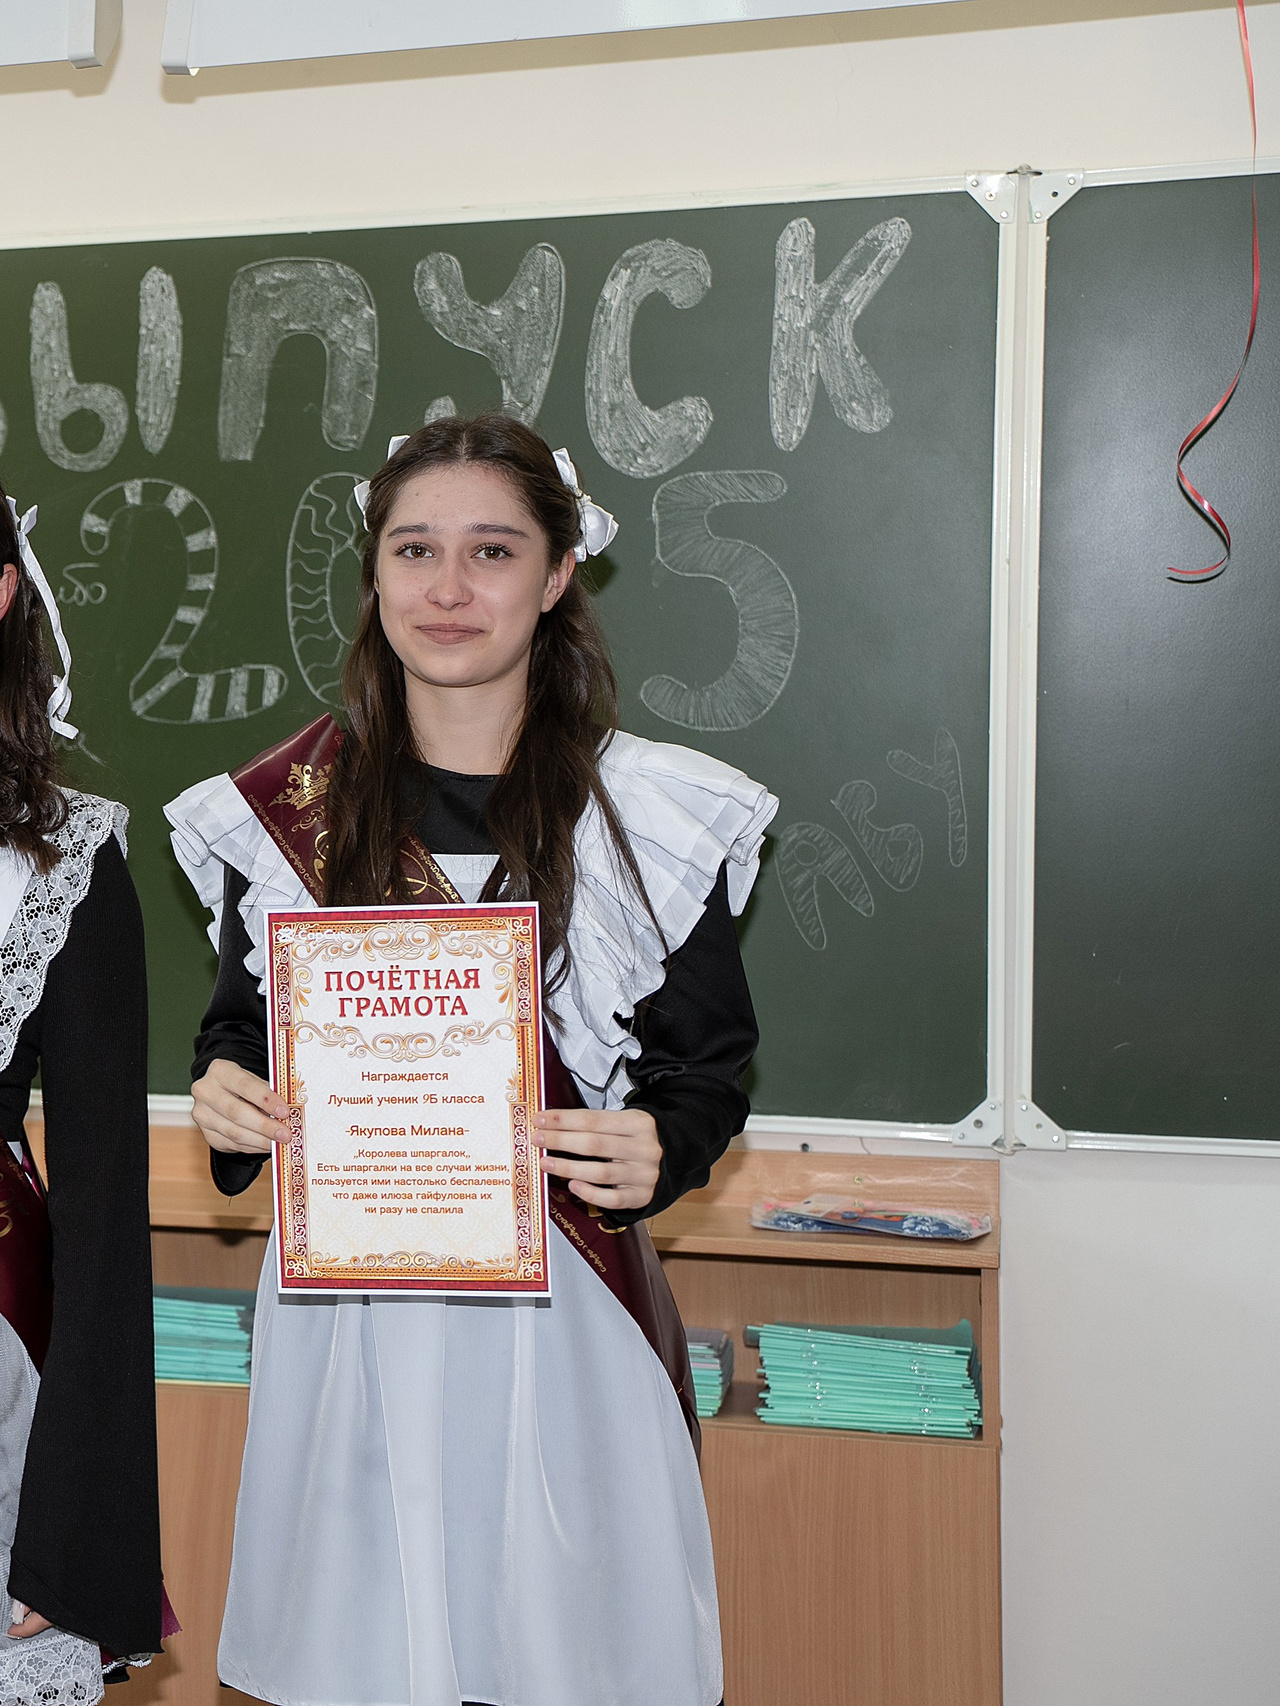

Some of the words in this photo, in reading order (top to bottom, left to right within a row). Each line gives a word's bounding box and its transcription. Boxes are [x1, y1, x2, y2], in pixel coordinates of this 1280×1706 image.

[81, 470, 799, 731] 205
[324, 964, 481, 992] ПОЧЁТНАЯ
[338, 995, 469, 1018] ГРАМОТА
[361, 1071, 449, 1083] Награждается
[327, 1094, 374, 1107] Лучший
[376, 1096, 419, 1107] ученик
[422, 1093, 438, 1104] 9Б
[441, 1095, 485, 1104] класса
[317, 1162, 341, 1172] Есть
[342, 1164, 398, 1174] шпаргалки
[400, 1164, 413, 1172] на
[415, 1164, 433, 1172] все
[435, 1164, 472, 1174] случаи
[474, 1164, 510, 1173] жизни,
[311, 1178, 369, 1188] пользуется
[370, 1178, 391, 1186] ими
[393, 1178, 448, 1186] настолько
[449, 1176, 514, 1187] беспалевно,
[332, 1192, 350, 1200] что
[352, 1192, 379, 1201] даже
[380, 1192, 414, 1200] илюза
[415, 1190, 478, 1202] гайфуловна
[480, 1192, 493, 1200] их
[364, 1206, 377, 1214] ни
[379, 1206, 404, 1216] разу
[405, 1206, 418, 1214] не
[420, 1206, 464, 1214] спалила
